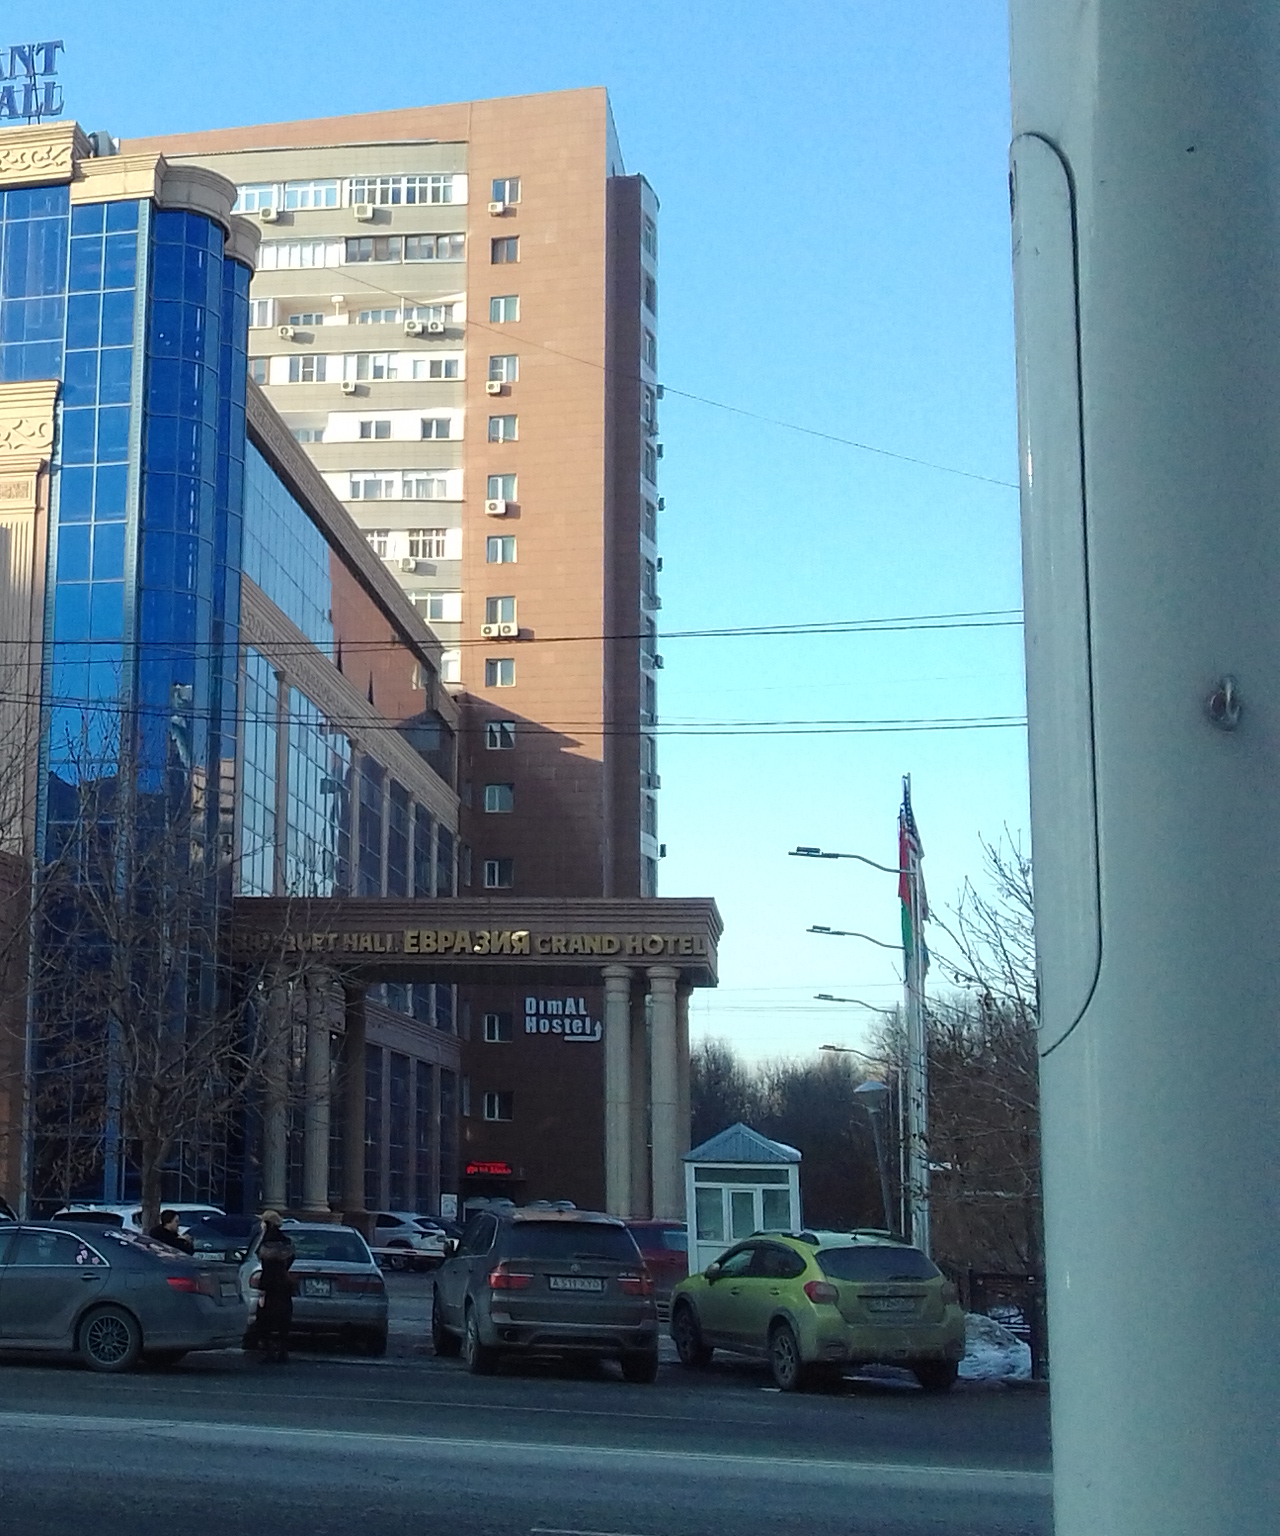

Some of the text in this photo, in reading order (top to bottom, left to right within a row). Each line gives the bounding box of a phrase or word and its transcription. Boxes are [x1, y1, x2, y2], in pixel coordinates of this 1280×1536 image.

[403, 930, 530, 954] ЕВРАЗИЯ
[536, 932, 621, 954] GRAND
[625, 933, 708, 955] HOTEL
[525, 1016, 591, 1034] Hostel
